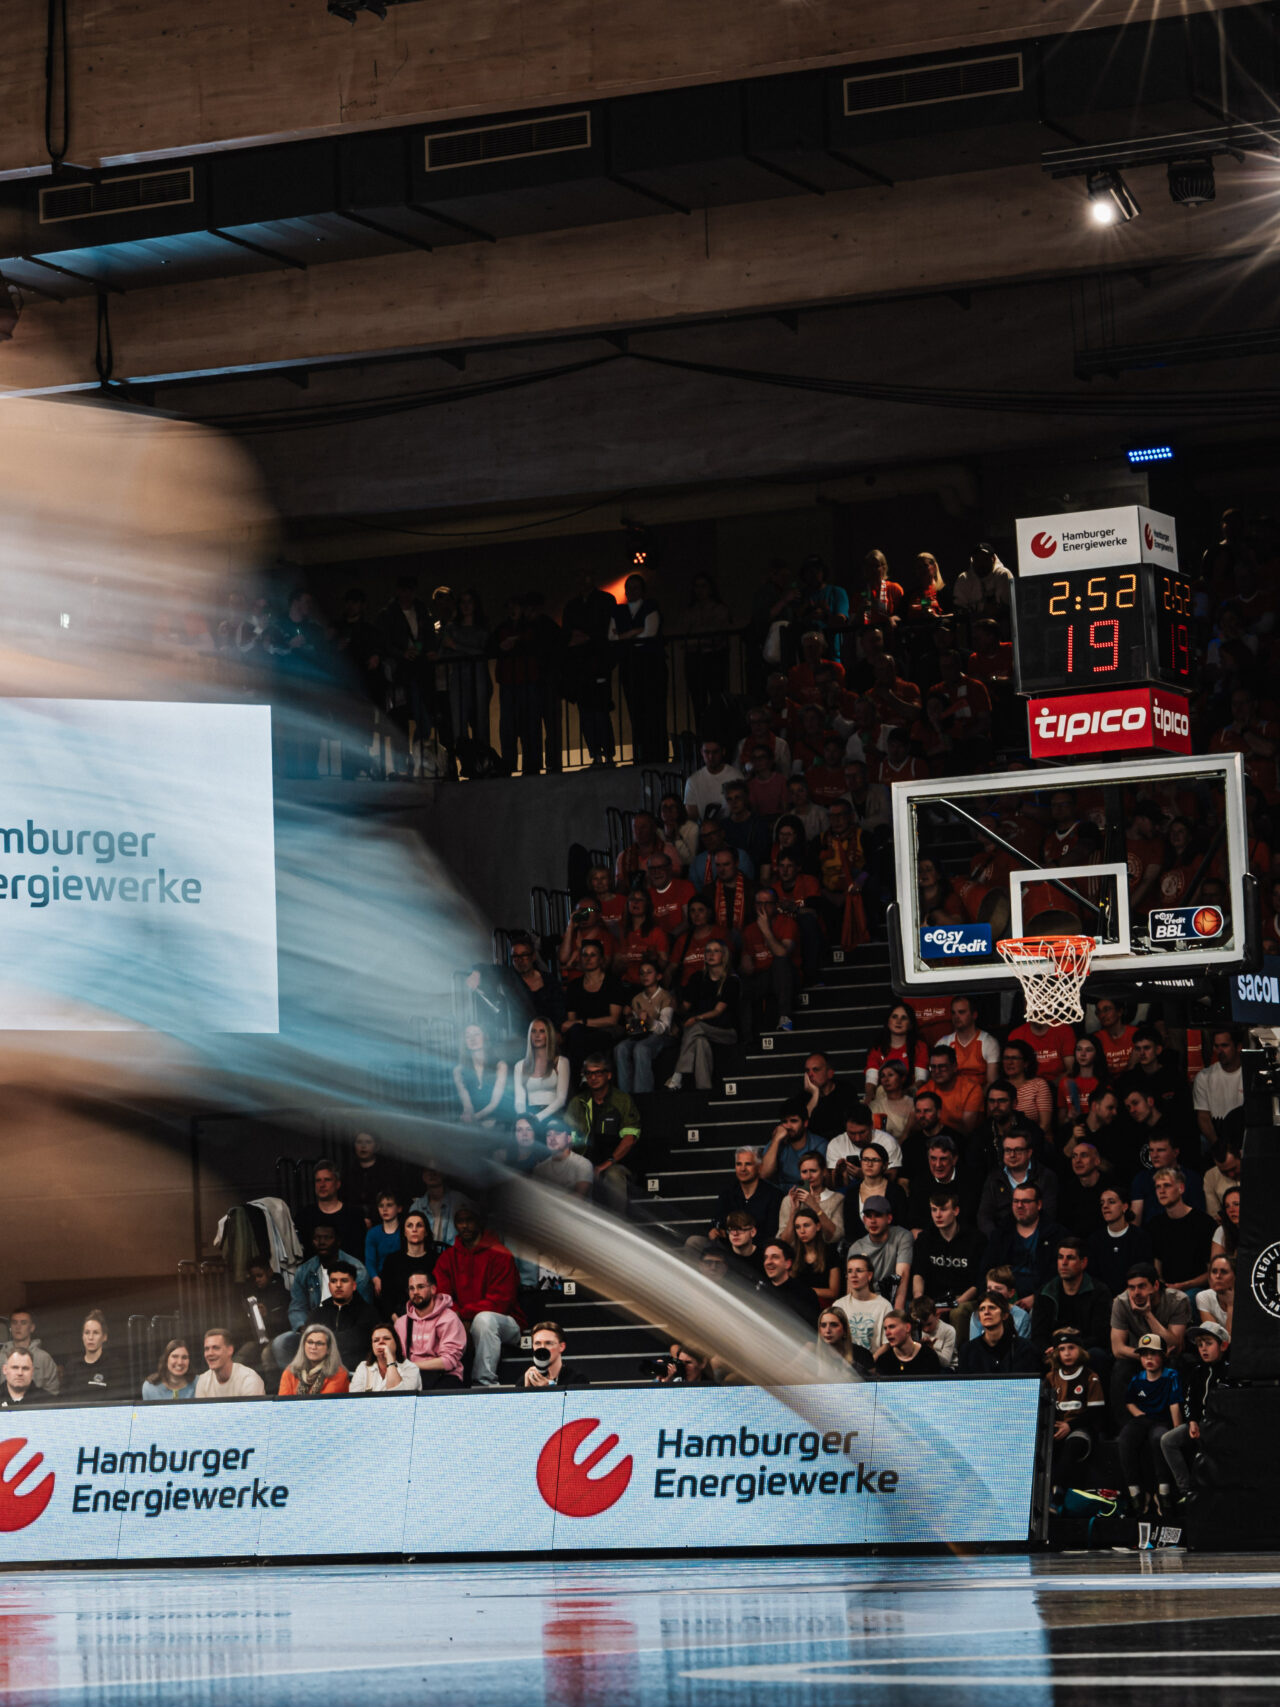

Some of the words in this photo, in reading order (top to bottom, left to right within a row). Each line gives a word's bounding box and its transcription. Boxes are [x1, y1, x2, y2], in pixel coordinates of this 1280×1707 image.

[1062, 529, 1115, 541] Hamburger
[1063, 537, 1128, 552] Energiewerke
[1049, 574, 1136, 616] 2:52
[1163, 577, 1191, 616] 2:52
[1067, 619, 1119, 673] 19
[1170, 623, 1189, 676] 19
[1035, 707, 1147, 743] tipico
[1153, 698, 1189, 737] tipico
[943, 939, 988, 954] Credit
[1155, 925, 1186, 938] BBL
[76, 1443, 256, 1477] Hamburger
[658, 1426, 859, 1461] Hamburger
[72, 1479, 289, 1517] Energiewerke
[654, 1462, 900, 1503] Energiewerke
